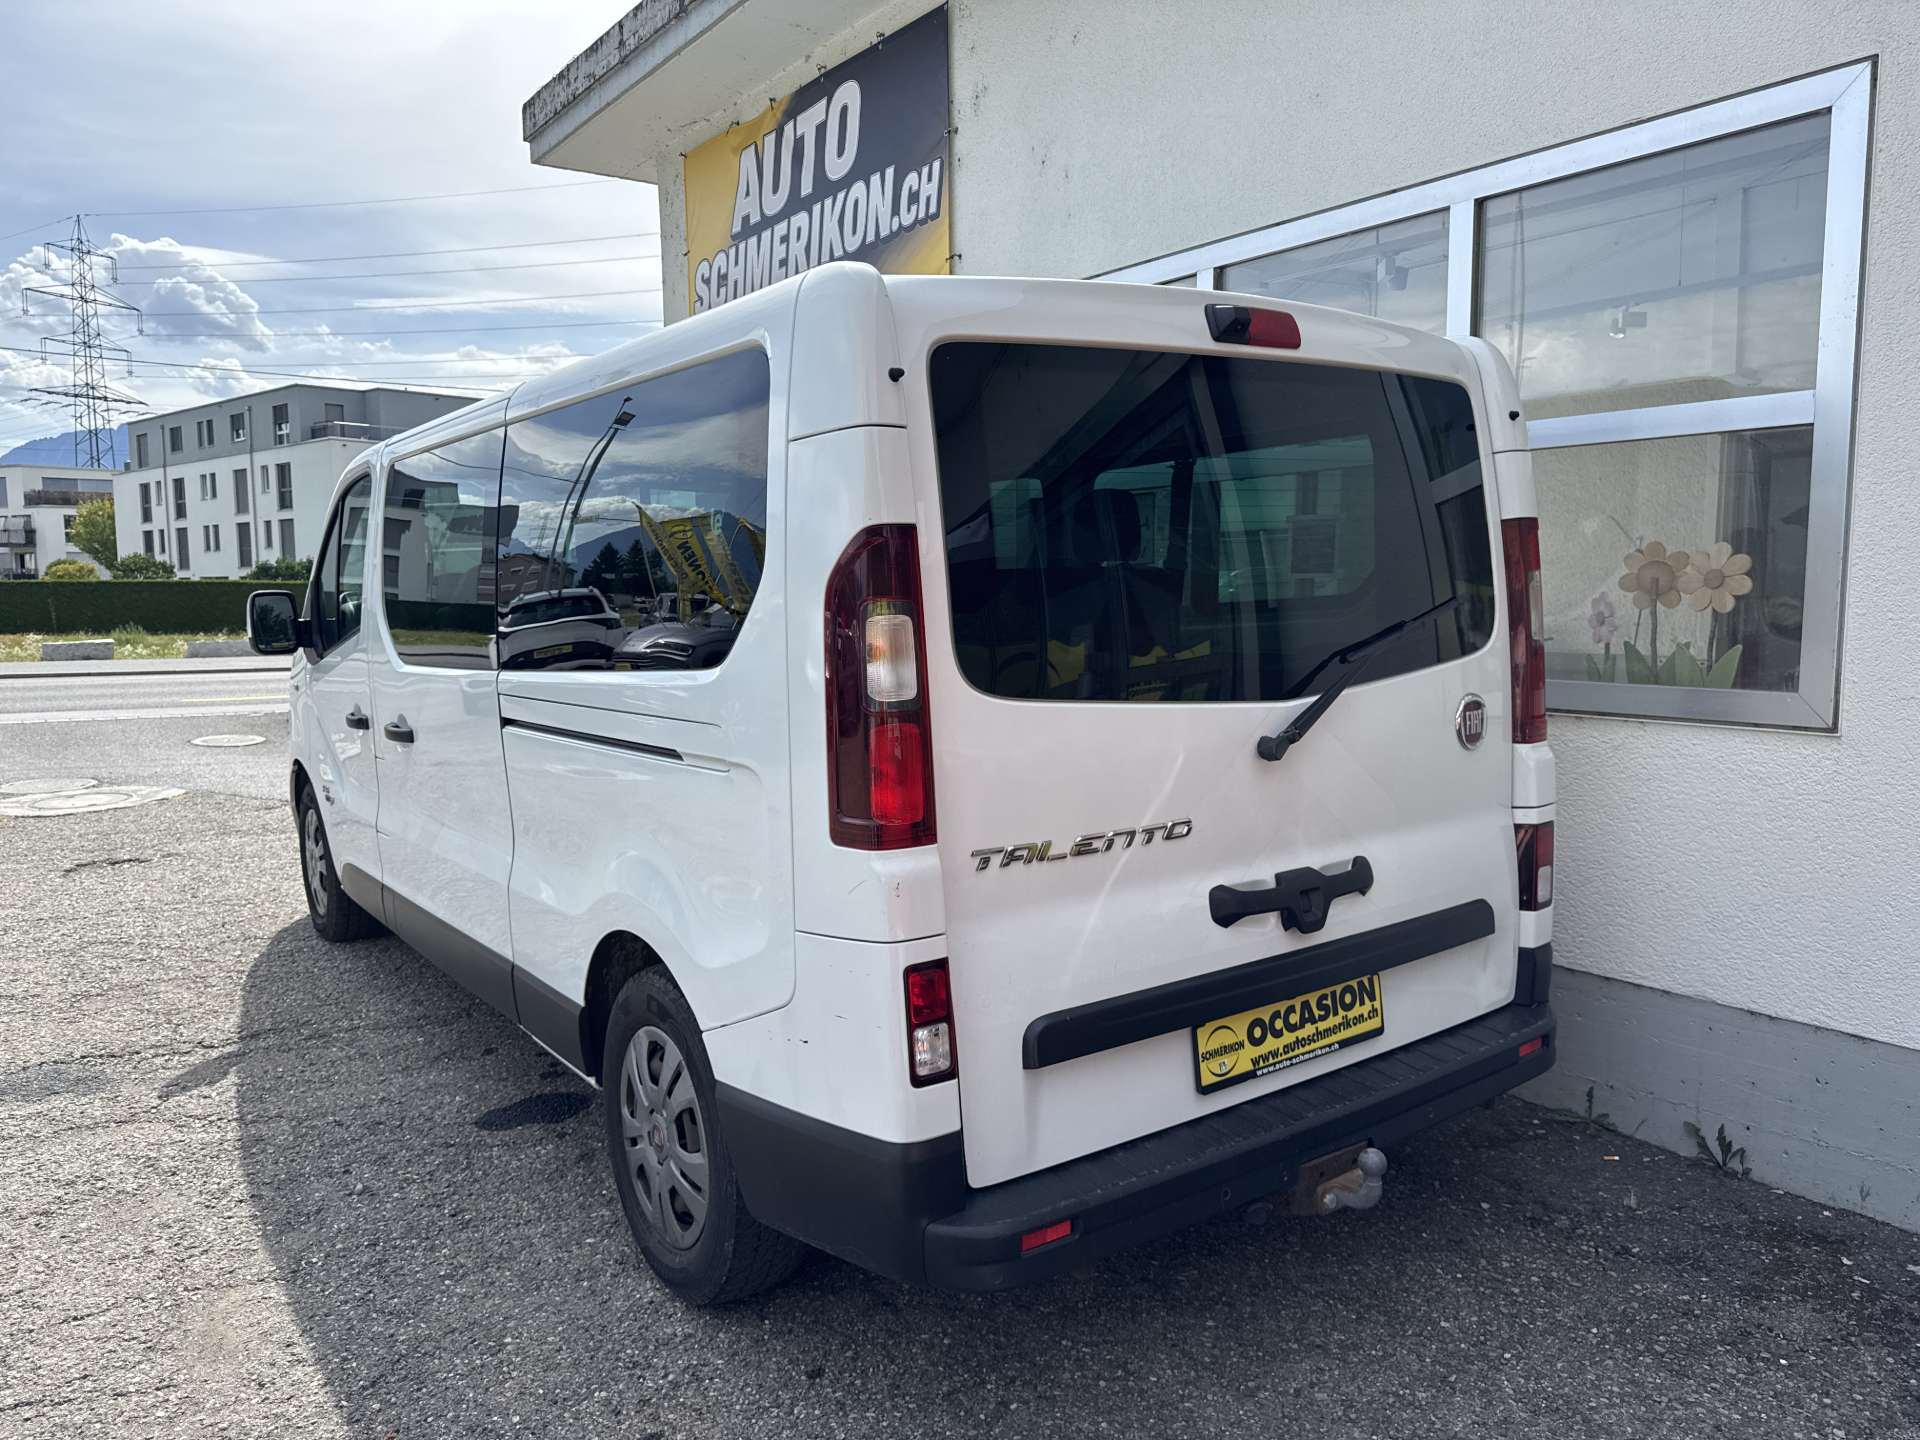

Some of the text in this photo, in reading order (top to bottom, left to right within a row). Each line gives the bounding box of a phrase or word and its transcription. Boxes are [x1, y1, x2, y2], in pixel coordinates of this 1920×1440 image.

[731, 79, 862, 236] AUTO
[694, 158, 943, 315] SCHMERIKON.CH
[1465, 709, 1482, 735] FIAT
[971, 816, 1193, 872] TALENTO
[1246, 976, 1377, 1048] OCCASION
[1250, 1003, 1379, 1070] www.autoschmerikon.ch
[1200, 1039, 1245, 1063] SCHMERIKON
[1256, 1043, 1340, 1077] www.auto-schmerikon.ch
